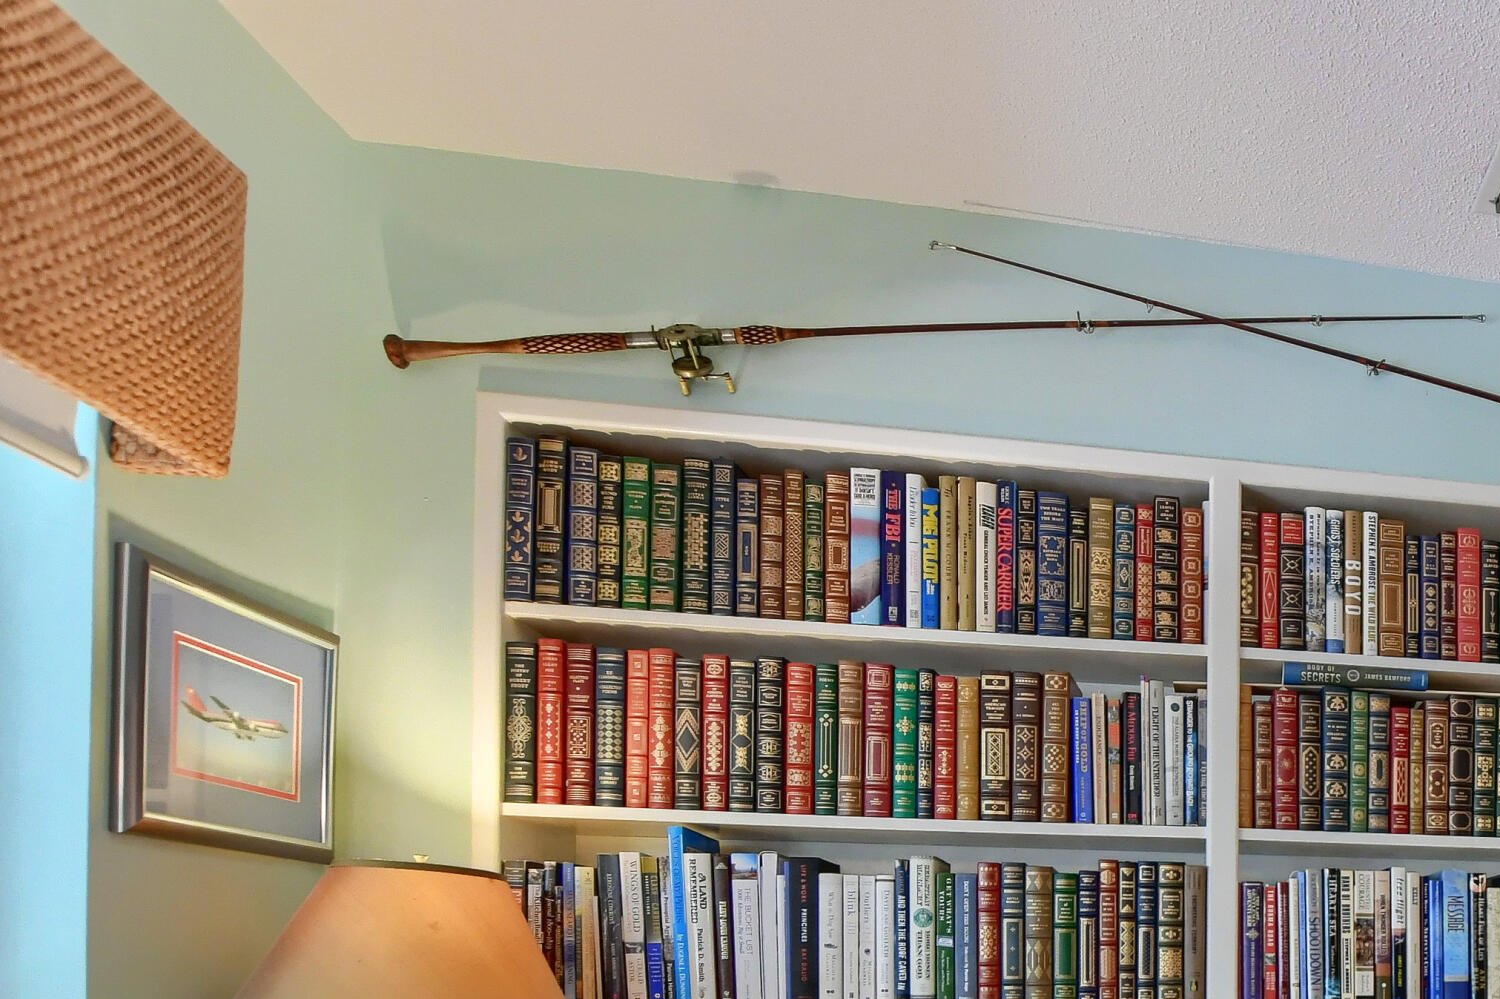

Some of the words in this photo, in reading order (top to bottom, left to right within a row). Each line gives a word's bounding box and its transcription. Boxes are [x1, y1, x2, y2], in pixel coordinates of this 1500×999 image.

[888, 490, 899, 510] THE
[886, 513, 900, 542] FBI
[982, 504, 994, 530] YEAGER
[997, 508, 1012, 551] SUPER
[923, 538, 938, 583] PILOT
[1330, 547, 1340, 585] SOLDIERS
[997, 553, 1013, 612] CARRIER
[1345, 560, 1361, 616] BOYD
[1368, 592, 1376, 605] THE
[1301, 671, 1341, 683] SECRETS
[1186, 700, 1194, 727] STRANGER
[1152, 733, 1159, 743] OF
[630, 860, 639, 892] WINGS
[1342, 876, 1350, 892] BAND
[1396, 878, 1404, 896] free
[631, 893, 640, 905] OF
[689, 859, 698, 923] REMEMBERED
[699, 886, 707, 909] LAND
[744, 888, 752, 902] THE
[847, 890, 856, 916] blink
[1329, 880, 1337, 910] HEART
[631, 907, 641, 933] GOLD
[1342, 904, 1350, 933] BROTHERS
[1396, 899, 1404, 924] flight
[1447, 896, 1464, 933] MESSAGE
[745, 939, 753, 955] LIST
[1309, 917, 1321, 985] SHOOTDOWN
